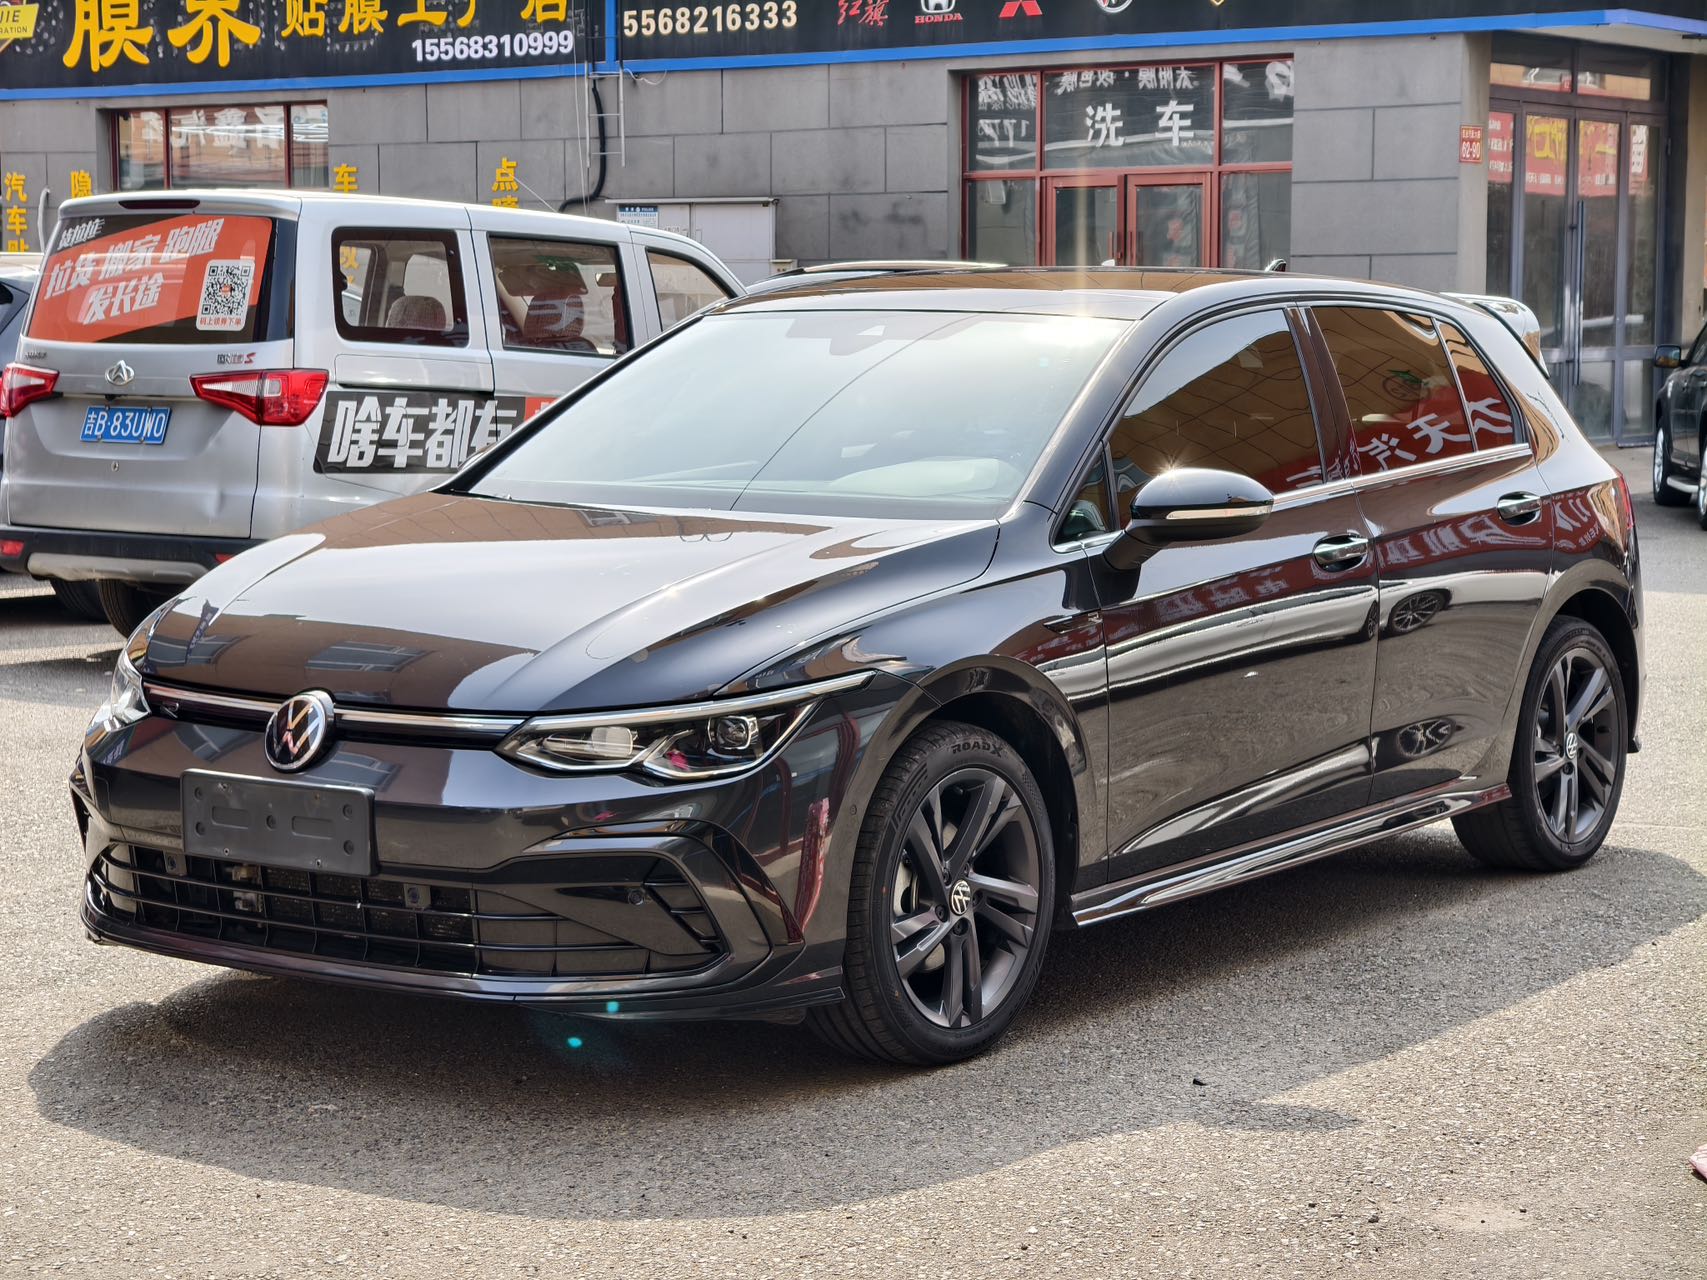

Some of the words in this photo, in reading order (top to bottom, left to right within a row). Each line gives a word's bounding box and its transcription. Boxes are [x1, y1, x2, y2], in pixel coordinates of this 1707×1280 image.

[623, 0, 798, 36] 5568216333
[915, 12, 963, 24] HONDA
[412, 30, 574, 61] 15568310999
[1085, 100, 1195, 147] 洗车
[334, 163, 358, 193] 车
[492, 156, 519, 208] 点
